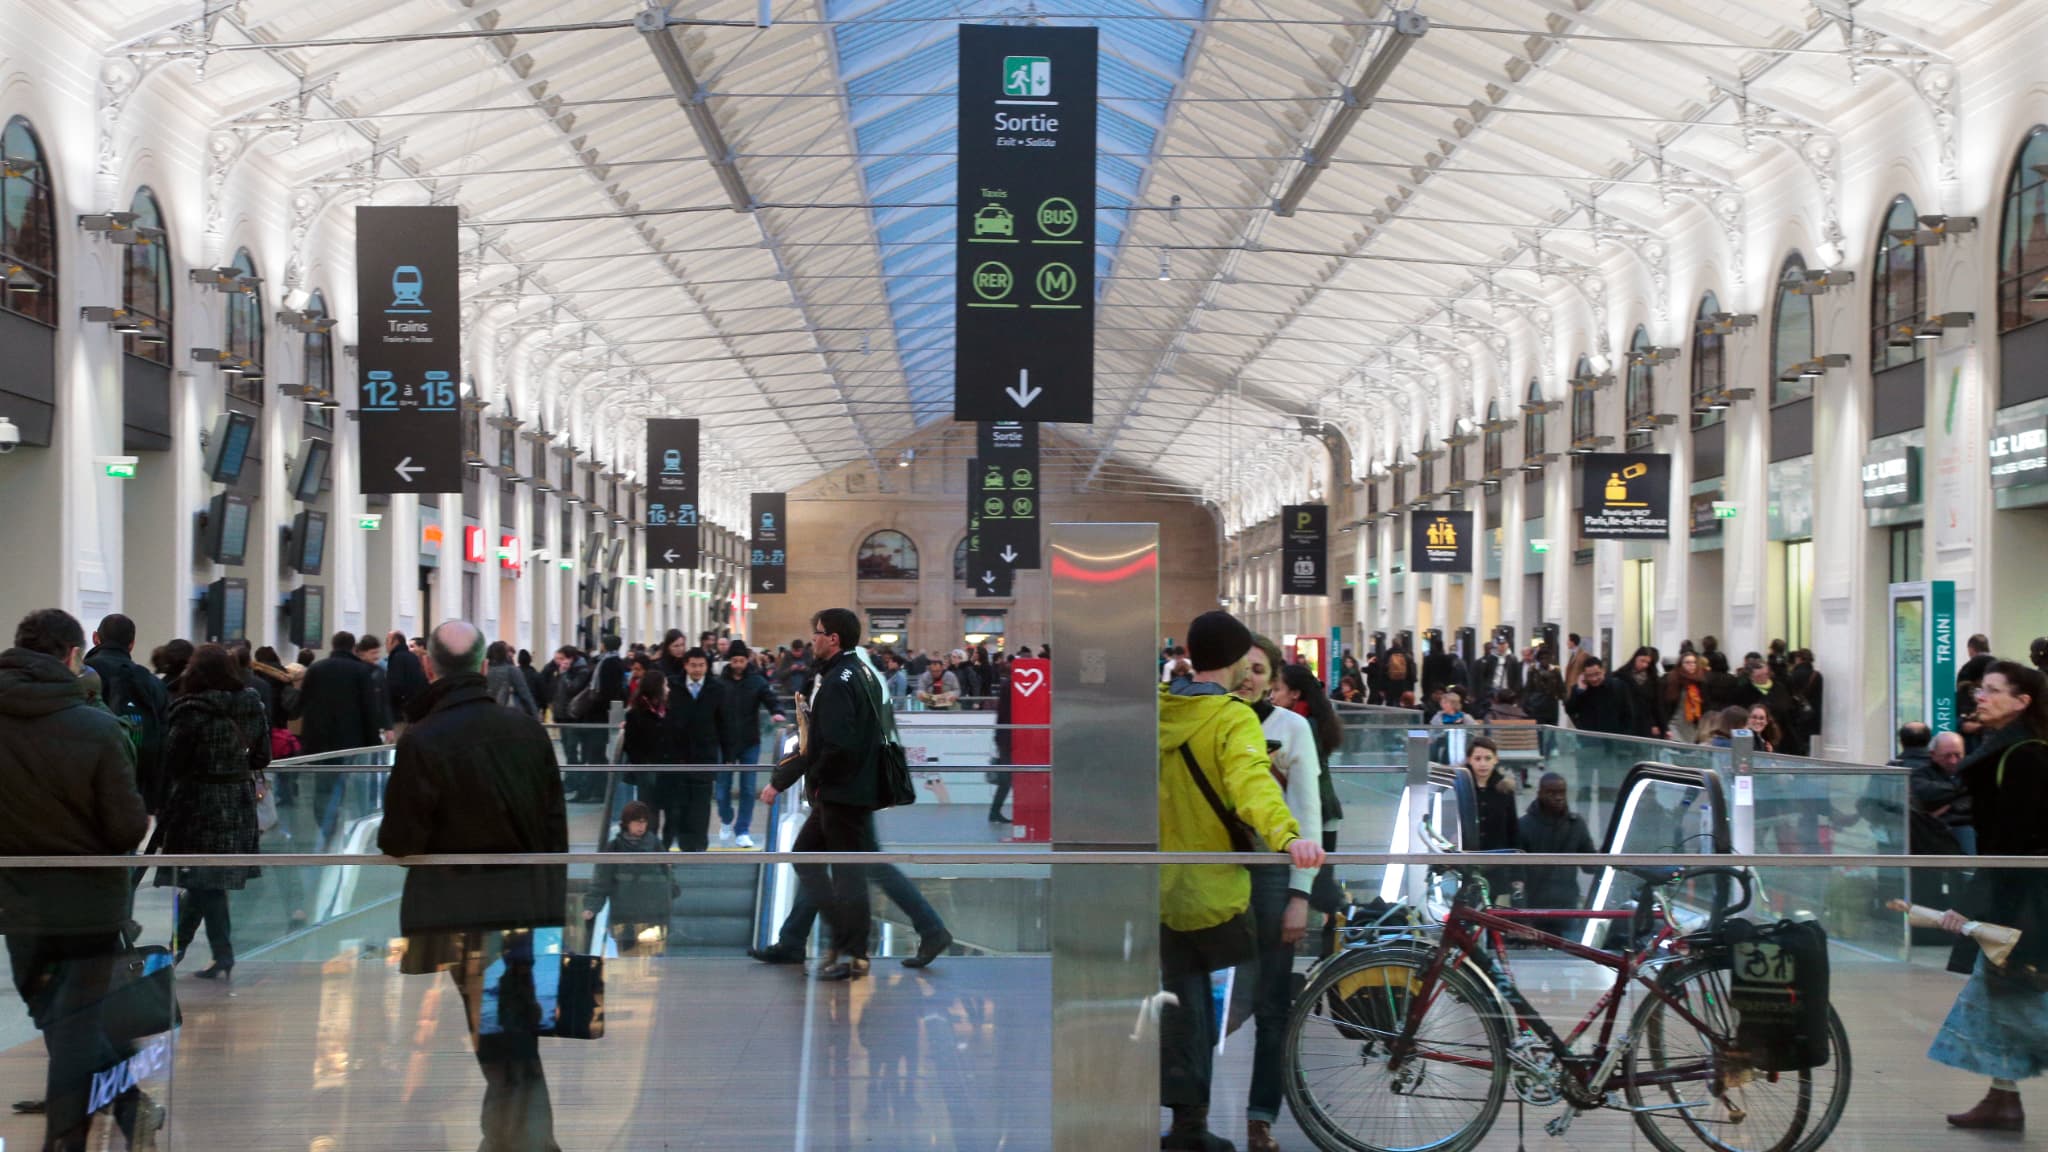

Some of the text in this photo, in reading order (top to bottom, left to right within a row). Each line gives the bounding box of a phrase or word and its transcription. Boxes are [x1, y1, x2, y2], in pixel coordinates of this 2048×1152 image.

[994, 112, 1059, 131] Sortie
[996, 136, 1057, 148] Exit Salida
[1043, 209, 1072, 225] BUS
[979, 273, 1008, 288] RER
[1045, 271, 1068, 293] M
[387, 320, 428, 332] Trains
[362, 381, 456, 406] 12 à 15
[648, 510, 666, 523] 16
[678, 510, 697, 523] 21
[1297, 512, 1312, 529] P
[1937, 697, 1951, 736] ARIS
